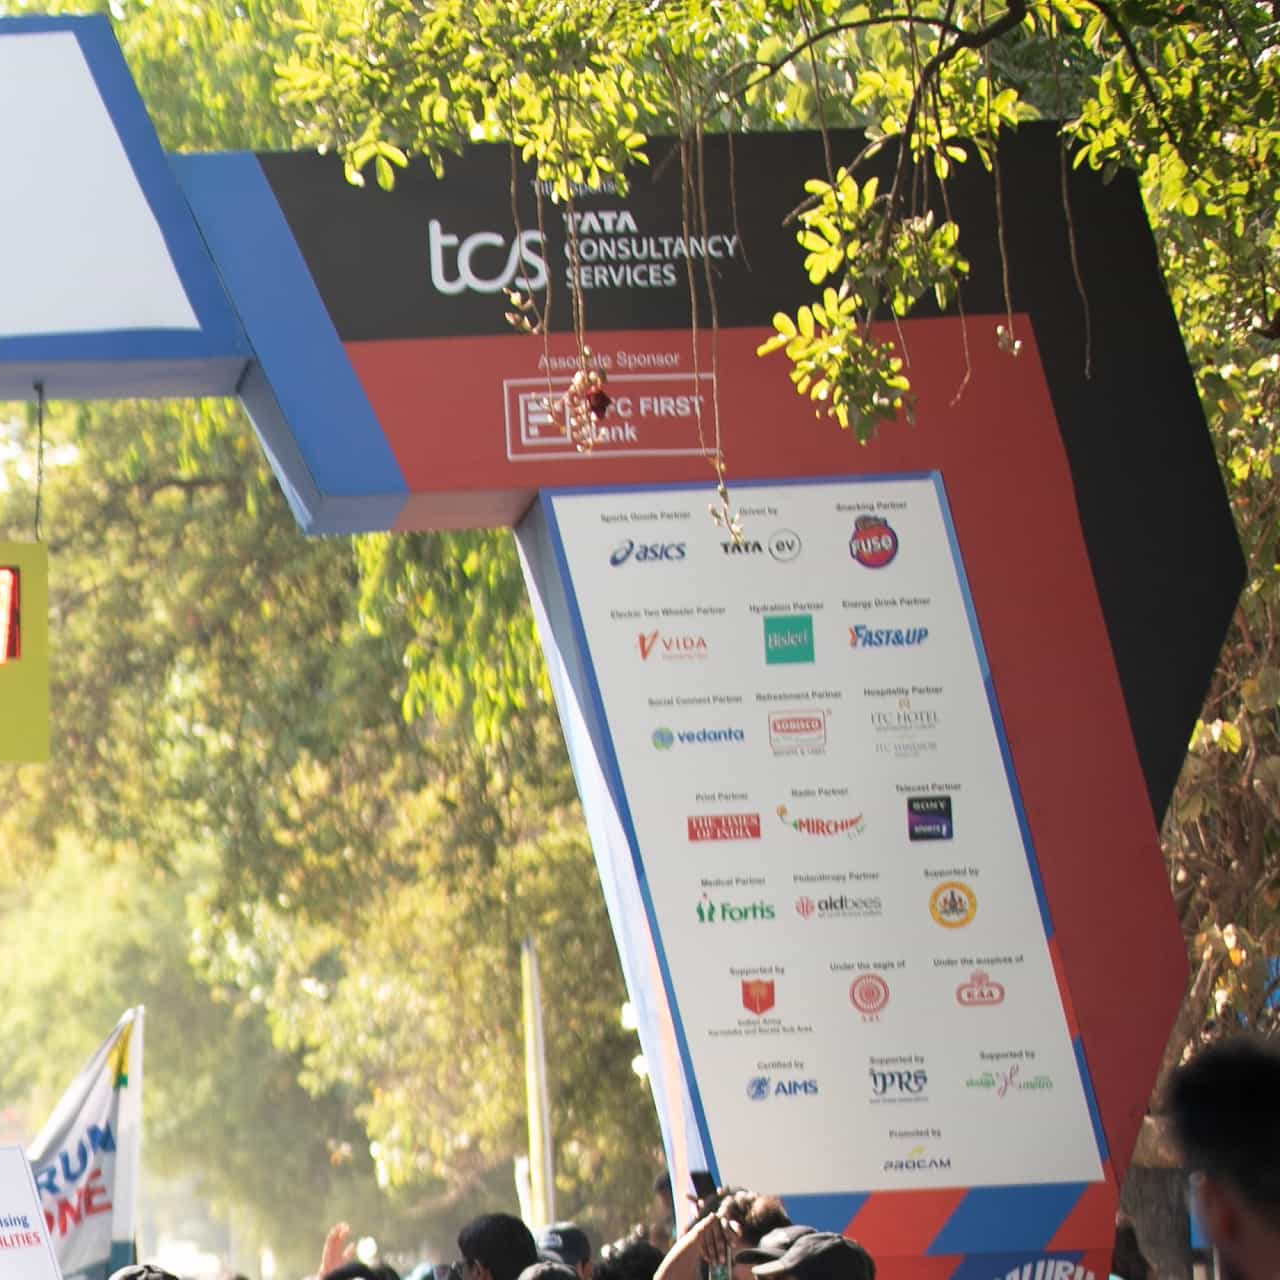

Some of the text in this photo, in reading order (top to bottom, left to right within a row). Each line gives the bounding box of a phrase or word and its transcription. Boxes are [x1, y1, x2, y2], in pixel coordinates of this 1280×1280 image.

[563, 209, 638, 234] TATA
[428, 218, 548, 294] tcs
[564, 234, 739, 262] CONSULTANCY
[566, 263, 677, 290] SERVICES
[615, 350, 681, 369] Sponsor
[639, 394, 705, 418] FIRST
[635, 541, 687, 562] asics
[662, 635, 708, 651] VIDA
[677, 727, 744, 745] vedanta
[720, 900, 775, 922] Fortis
[774, 1079, 818, 1096] AIMS
